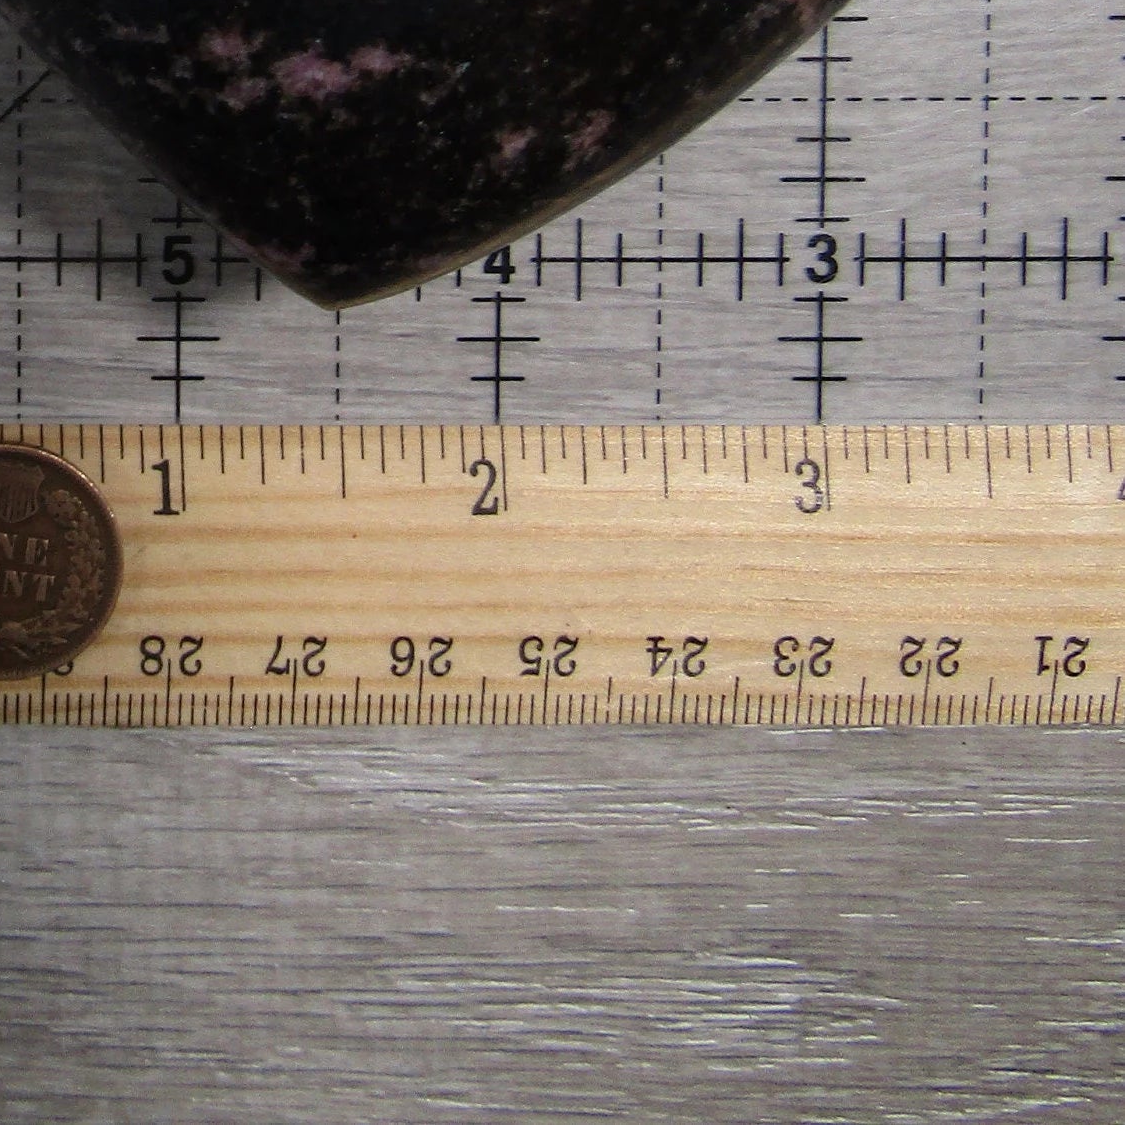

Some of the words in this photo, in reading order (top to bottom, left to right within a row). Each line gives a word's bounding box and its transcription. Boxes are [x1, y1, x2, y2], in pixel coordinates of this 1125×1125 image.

[162, 236, 196, 284] 5
[483, 245, 516, 284] 4
[806, 234, 839, 283] 3
[151, 459, 180, 516] 1
[469, 459, 499, 515] 2
[794, 458, 823, 513] 3
[139, 635, 204, 676] 28
[265, 635, 327, 676] 27
[390, 635, 453, 677] 26
[518, 635, 579, 677] 25
[646, 635, 709, 677] 24
[774, 635, 835, 677] 23
[899, 635, 963, 677] 22
[1034, 635, 1091, 677] 21
